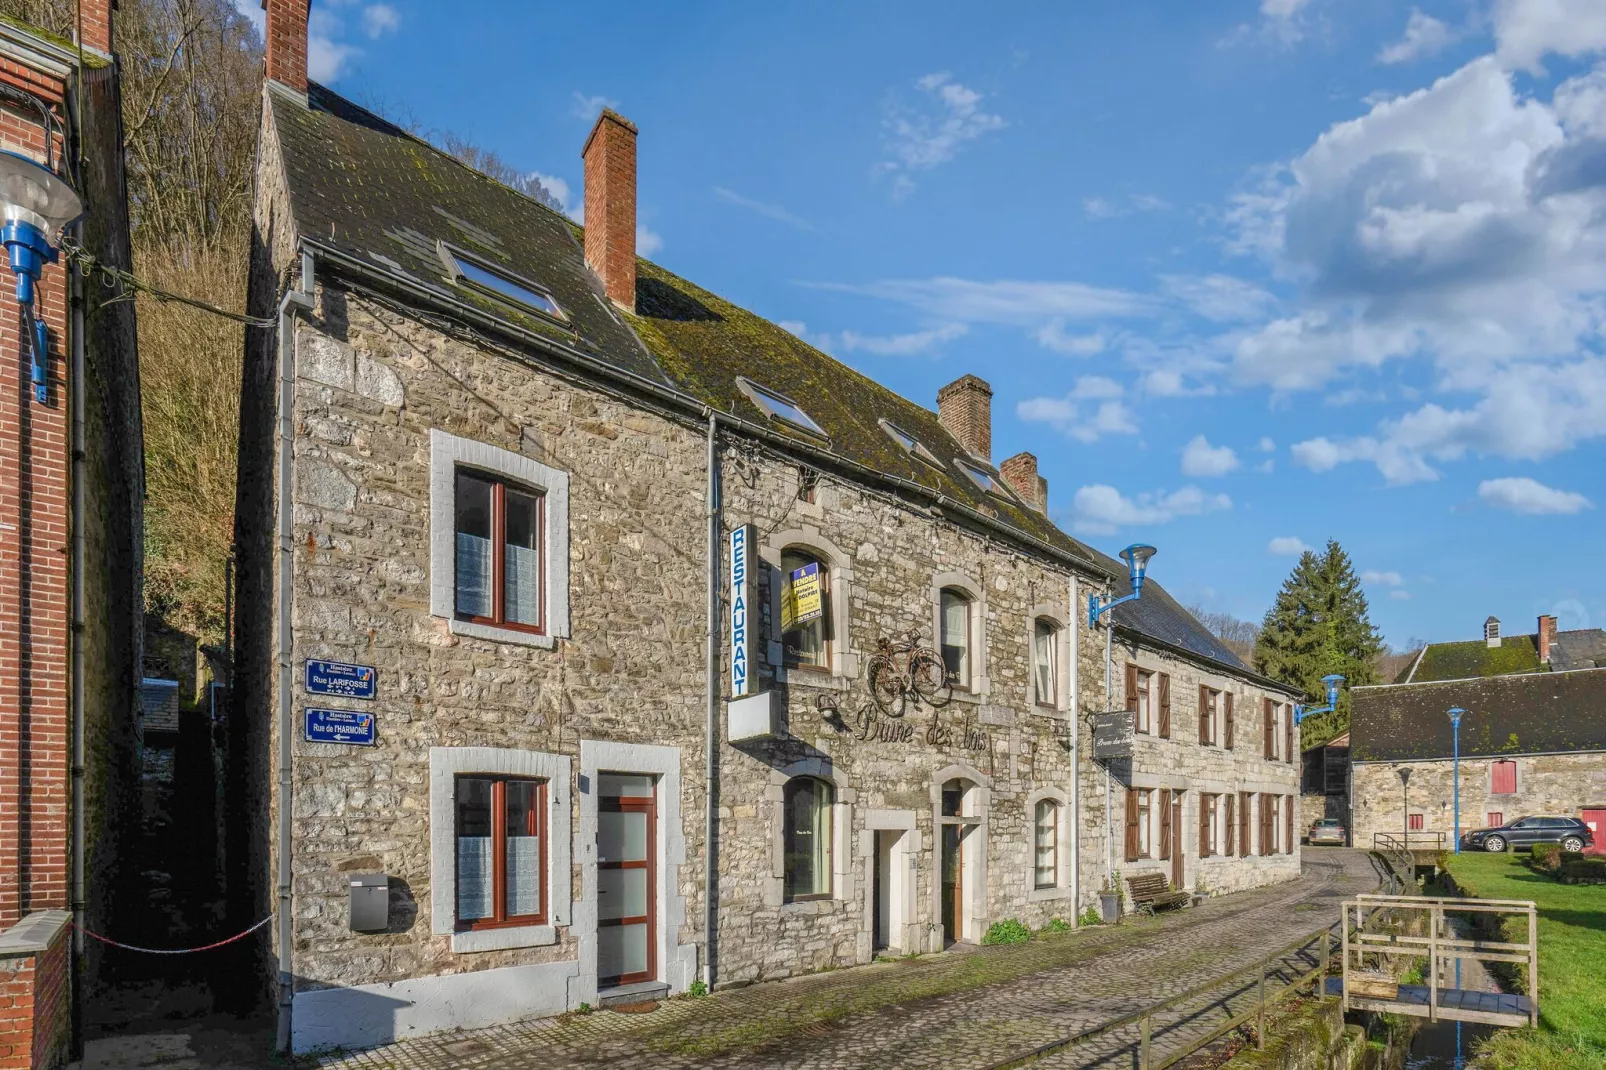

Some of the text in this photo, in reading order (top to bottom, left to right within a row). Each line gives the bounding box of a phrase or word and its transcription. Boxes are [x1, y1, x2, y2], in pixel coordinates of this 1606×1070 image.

[792, 573, 817, 588] VENDRE
[733, 528, 746, 695] RESTAURANT
[313, 676, 368, 689] Rue LARIFOSSE
[313, 723, 368, 735] Rue de l'HARMONIE
[926, 712, 953, 747] des
